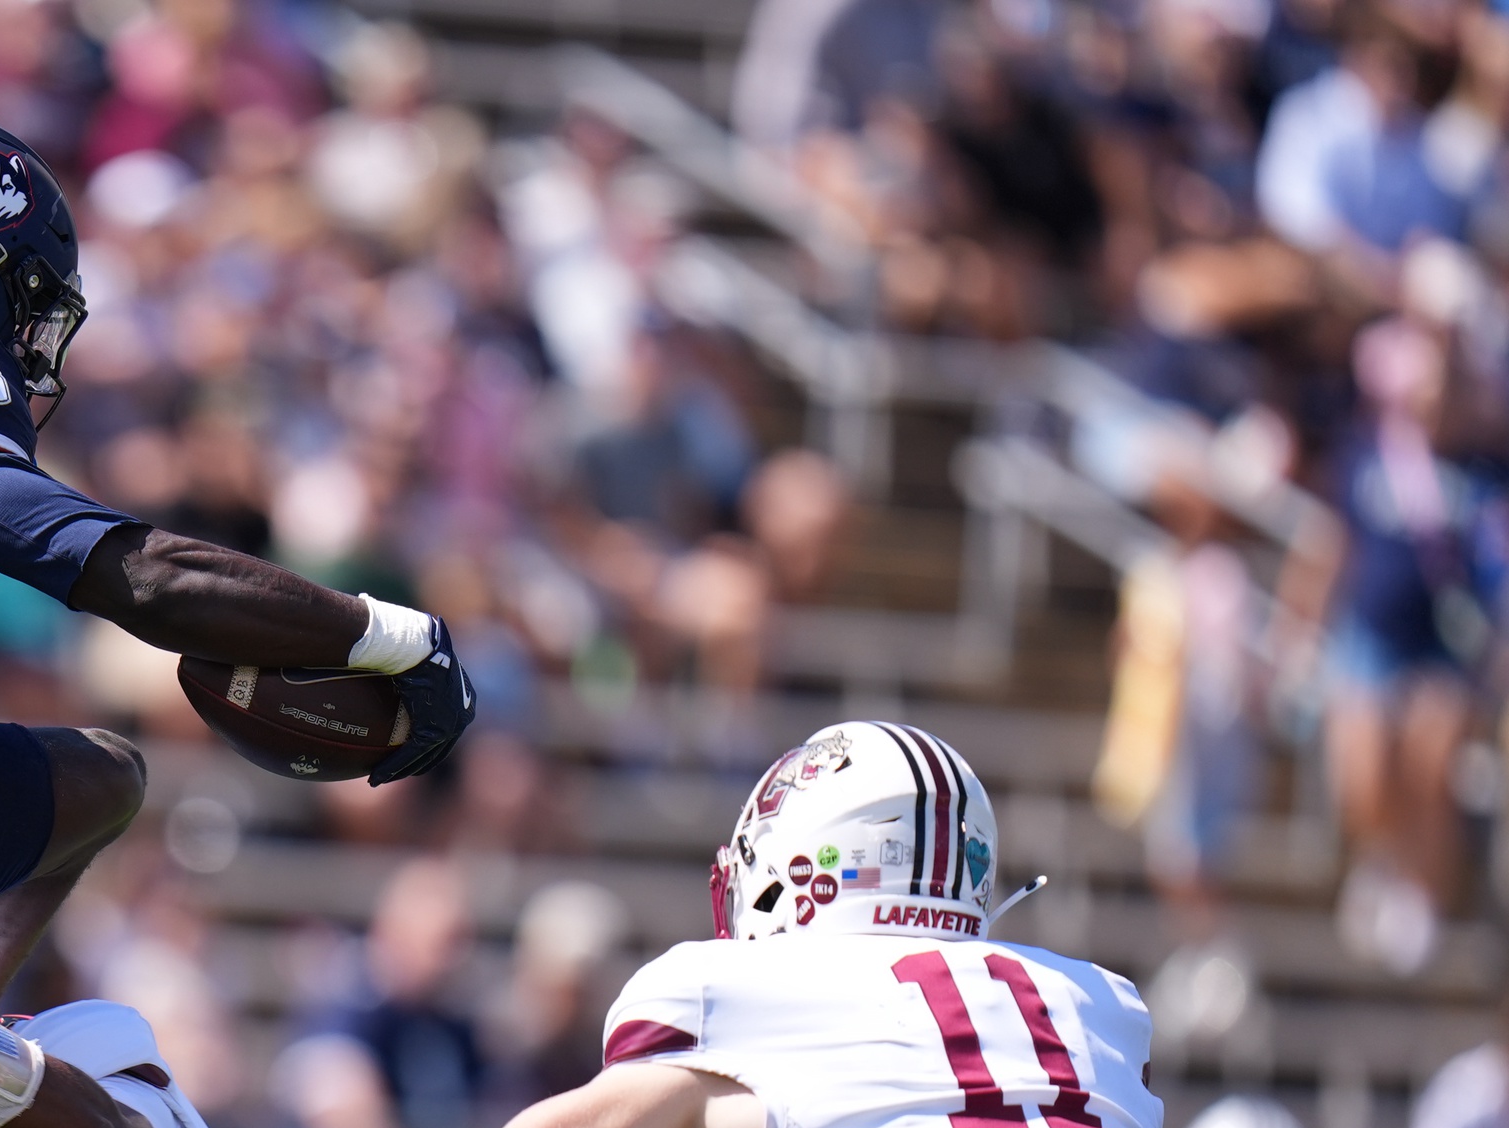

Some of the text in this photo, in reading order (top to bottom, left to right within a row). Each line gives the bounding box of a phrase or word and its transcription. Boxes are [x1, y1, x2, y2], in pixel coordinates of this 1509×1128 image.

[279, 702, 370, 737] VAPOR ELITE
[872, 904, 983, 937] LAFAYETTE
